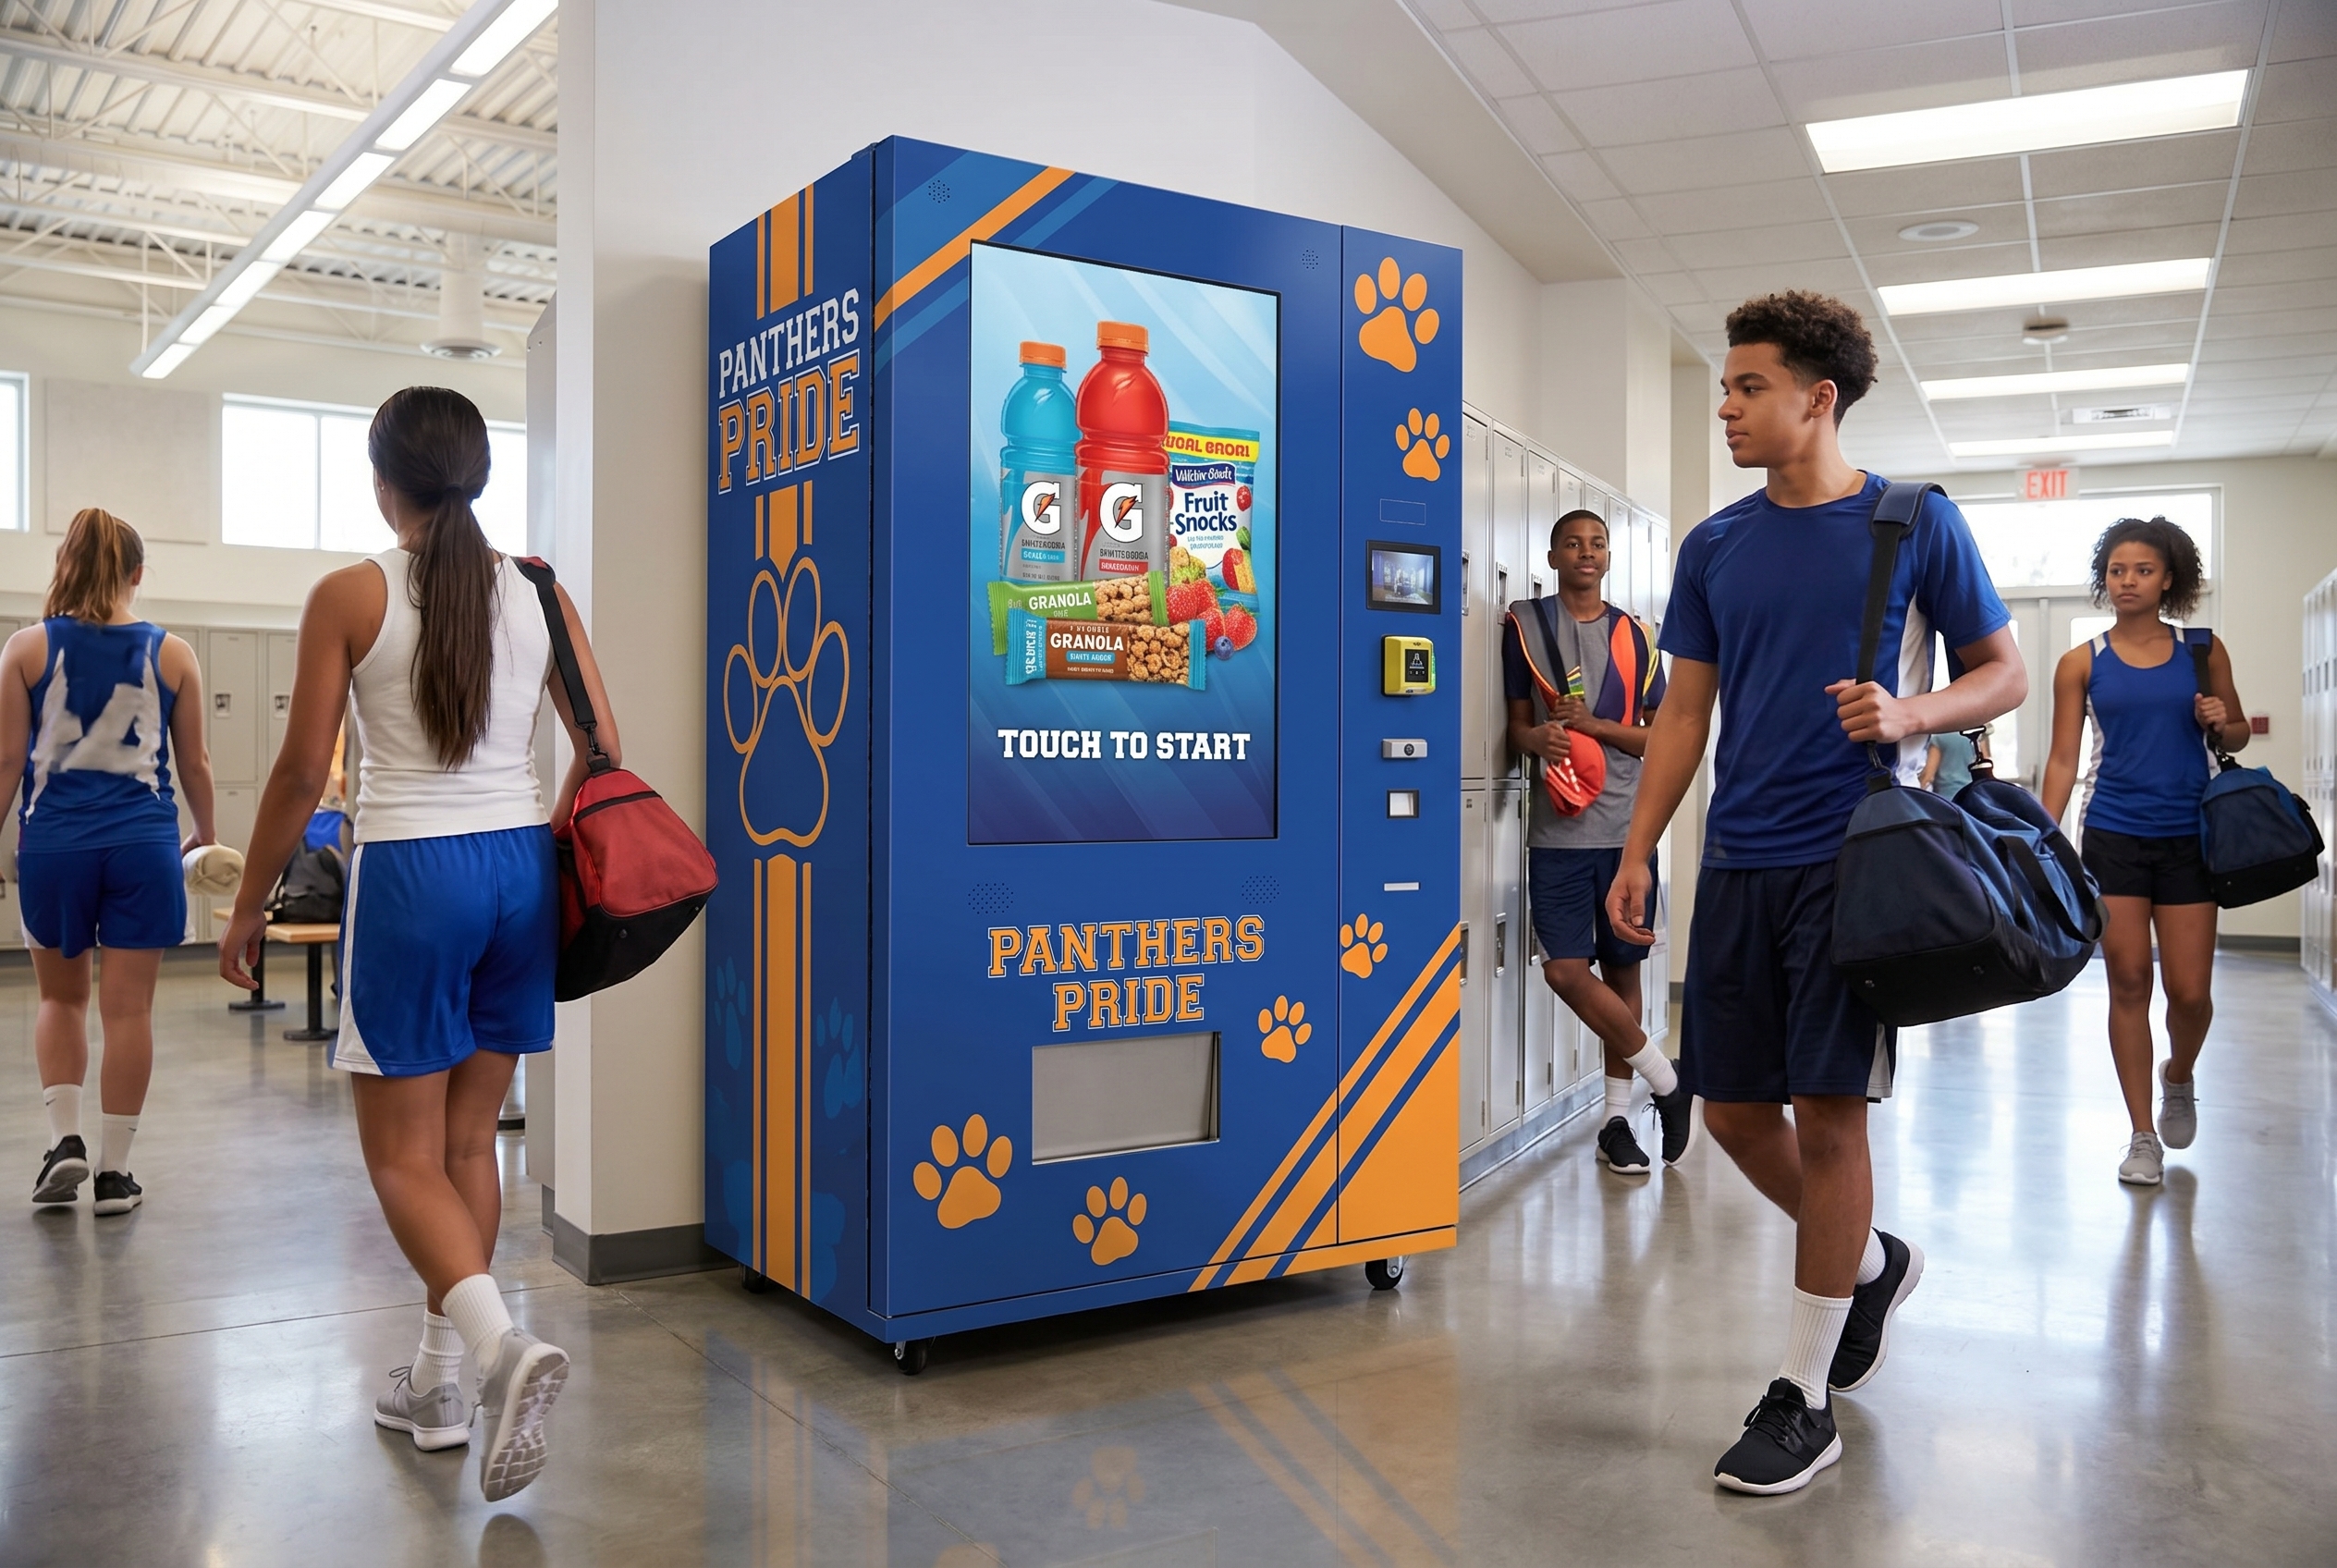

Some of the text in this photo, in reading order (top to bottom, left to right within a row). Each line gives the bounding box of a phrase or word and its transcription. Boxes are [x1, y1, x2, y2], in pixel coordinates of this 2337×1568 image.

[719, 288, 859, 398] PANTHERS
[718, 349, 860, 495] PRIDE
[1184, 491, 1229, 512] Fruit
[2026, 470, 2069, 499] EXIT
[1021, 481, 1061, 535] G
[1099, 482, 1144, 543] G
[1175, 512, 1237, 535] Snocks
[1028, 592, 1092, 610] GRANOLA
[1050, 632, 1124, 651] GRANOLA
[997, 729, 1251, 760] TOUCH TO START
[988, 914, 1265, 978] PANTHERS
[1052, 973, 1205, 1033] PRIDE
